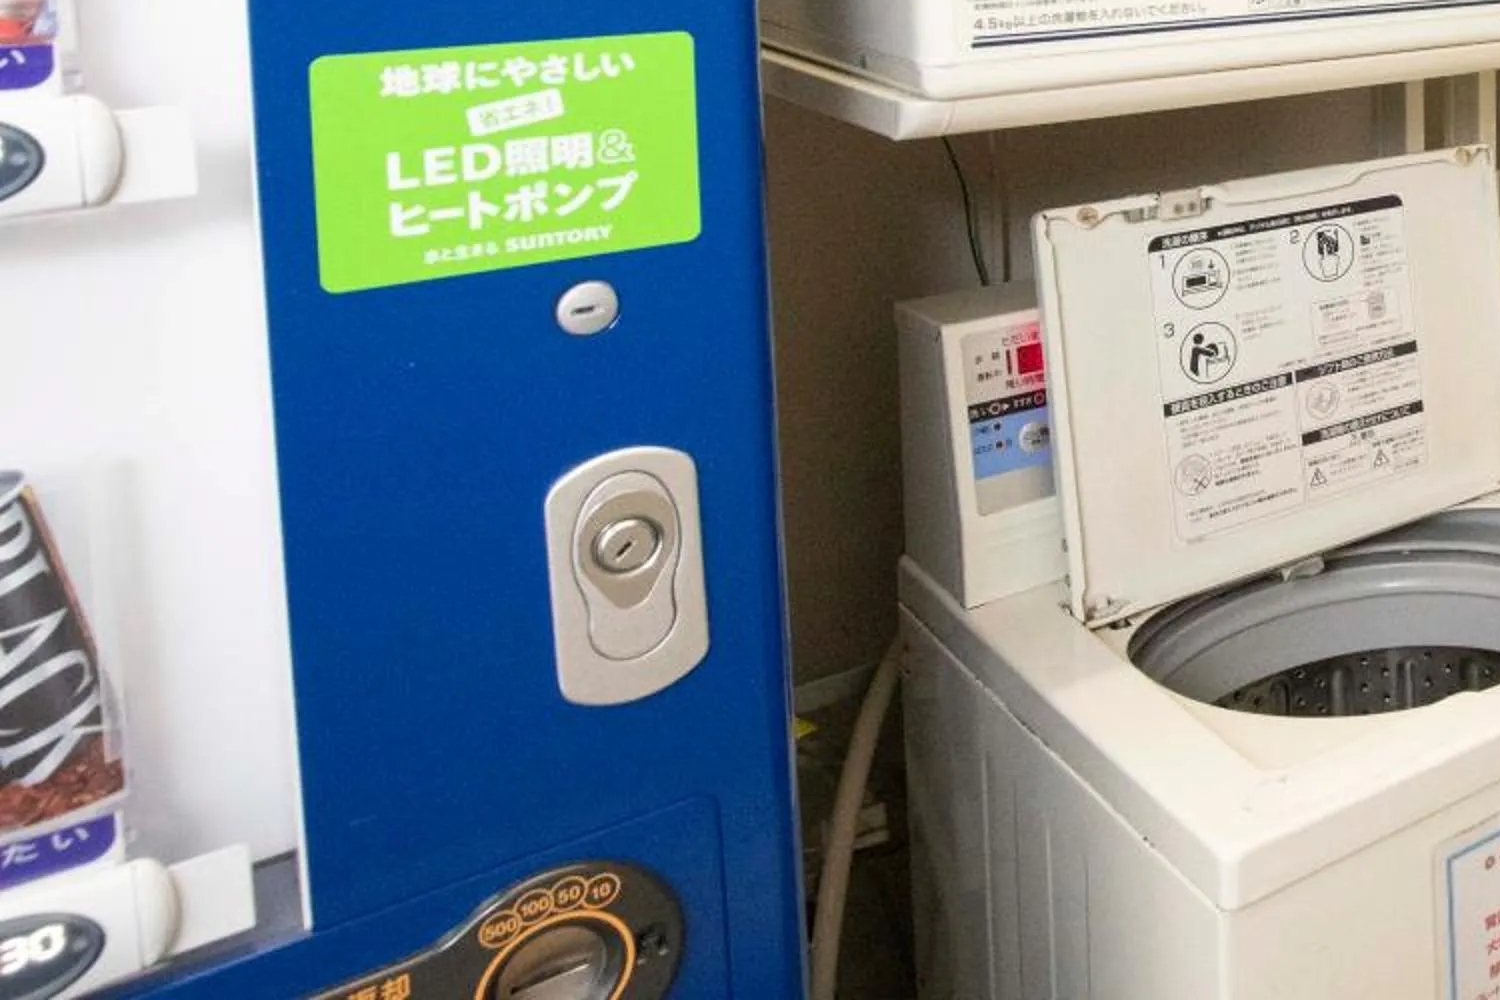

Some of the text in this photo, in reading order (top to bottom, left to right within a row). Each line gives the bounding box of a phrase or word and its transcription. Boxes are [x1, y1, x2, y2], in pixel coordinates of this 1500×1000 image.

[380, 51, 636, 98] 地球にやさしい
[390, 170, 639, 238] ヒートポンプ
[506, 224, 613, 253] SUNTORY
[1163, 322, 1176, 338] 3
[484, 882, 610, 940] 500 100 50 10
